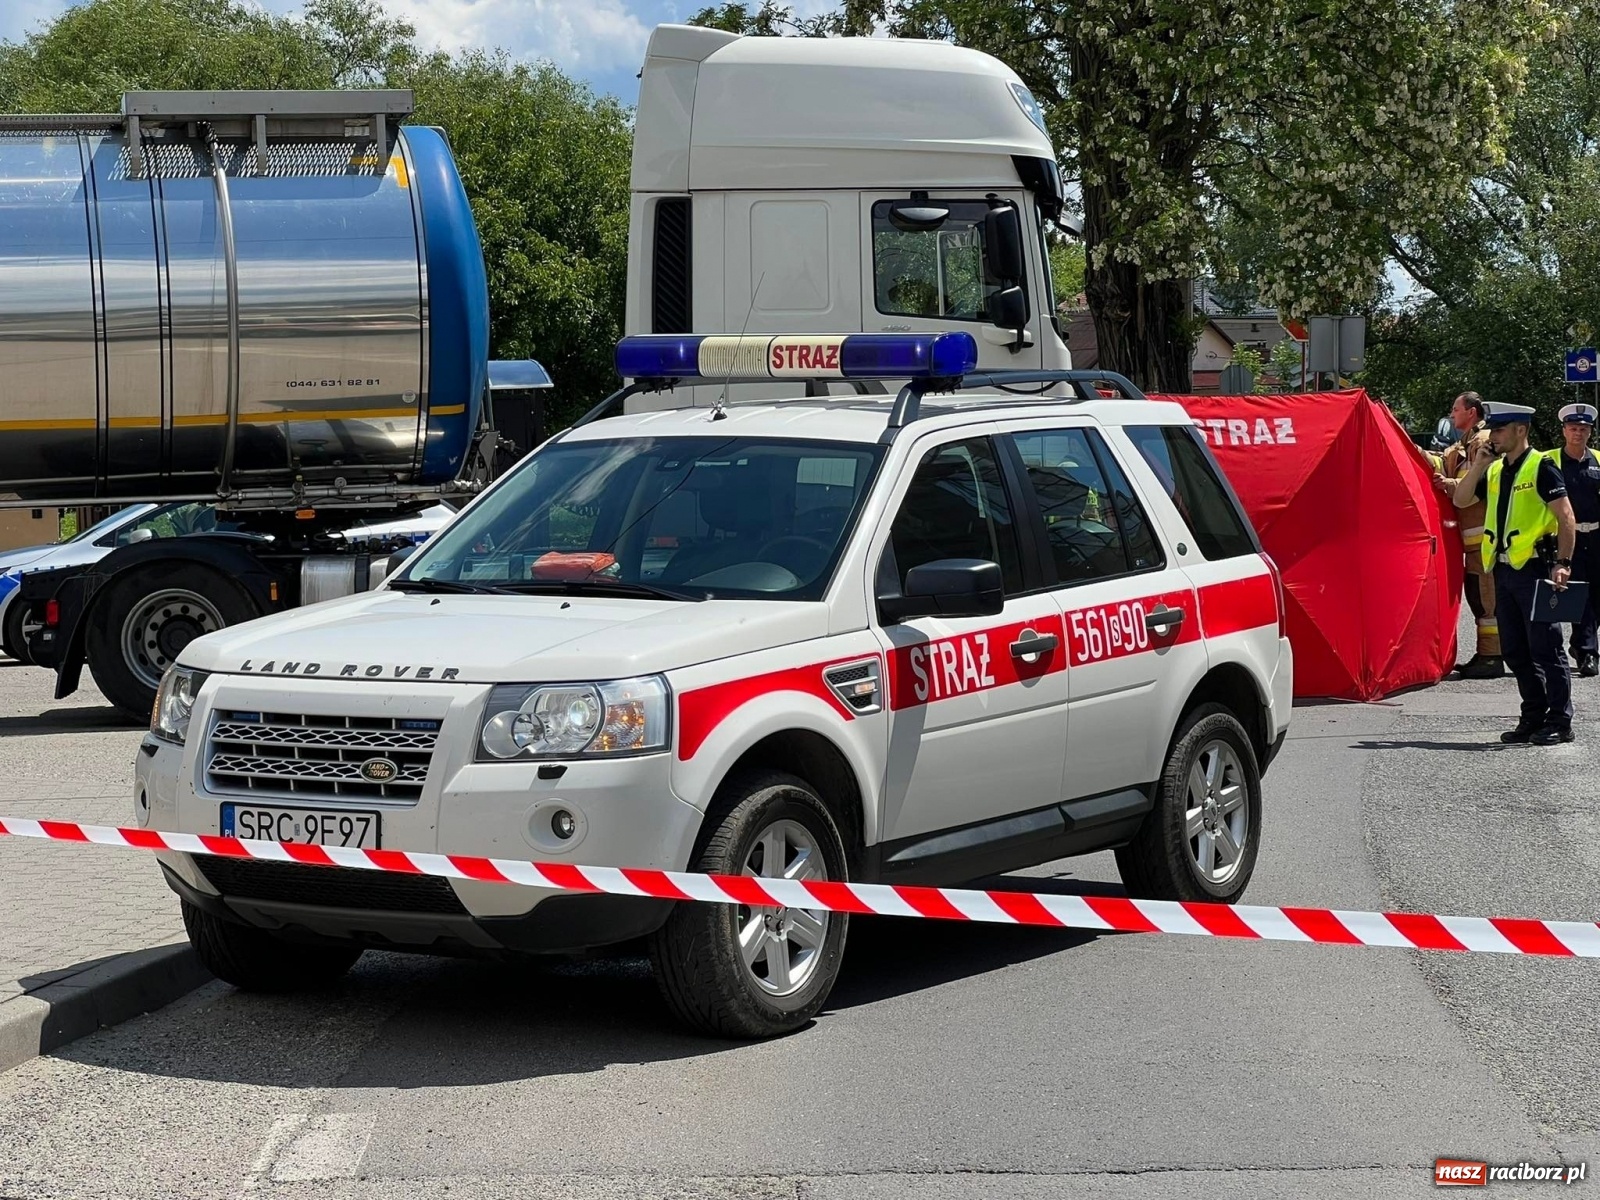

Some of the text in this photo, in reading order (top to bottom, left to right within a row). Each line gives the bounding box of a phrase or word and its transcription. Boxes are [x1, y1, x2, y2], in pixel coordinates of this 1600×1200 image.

[1513, 482, 1534, 492] POLICJA
[240, 659, 460, 680] LAND ROVER
[224, 829, 234, 838] PL
[239, 810, 372, 848] SRC 9F97
